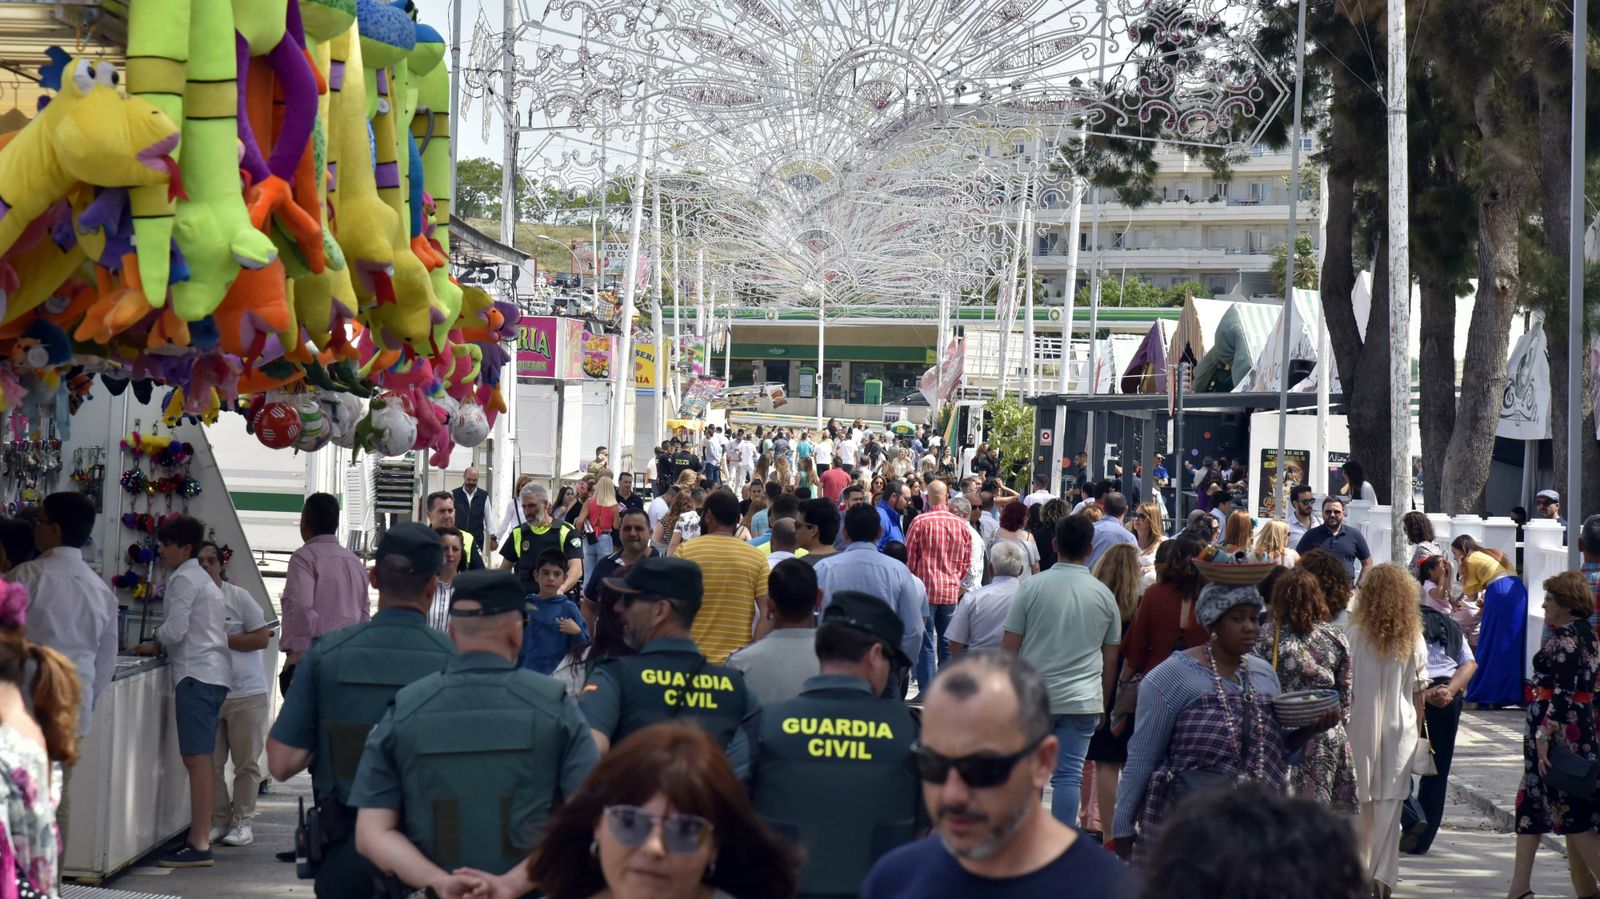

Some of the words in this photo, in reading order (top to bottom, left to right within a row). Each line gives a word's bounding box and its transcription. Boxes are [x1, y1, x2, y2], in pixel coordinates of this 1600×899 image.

[517, 326, 551, 360] RIA
[664, 688, 718, 709] CVIL
[782, 717, 894, 739] GUARDIA
[808, 738, 872, 760] CIVIL
